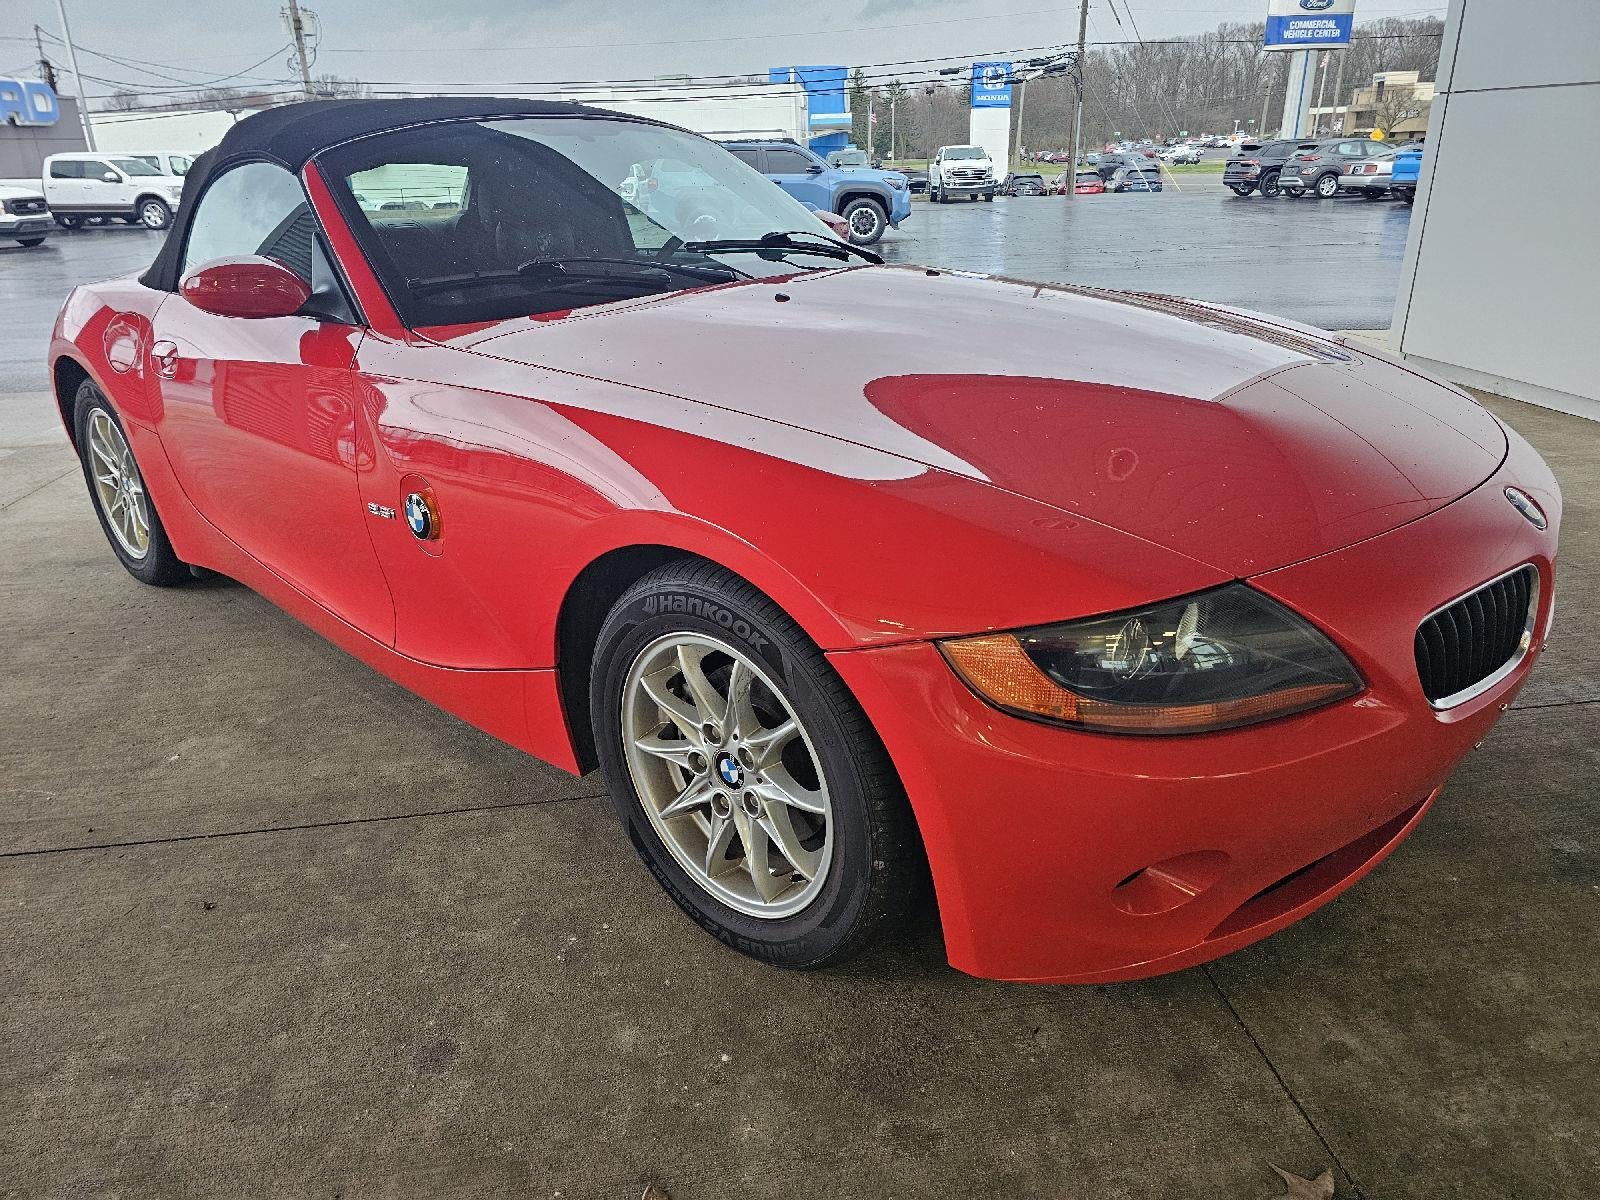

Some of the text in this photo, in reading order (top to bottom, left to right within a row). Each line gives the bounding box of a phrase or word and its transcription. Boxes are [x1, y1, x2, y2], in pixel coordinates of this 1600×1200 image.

[1289, 20, 1336, 29] COMMERCIAL
[1283, 29, 1340, 38] VEHICLE CENTER
